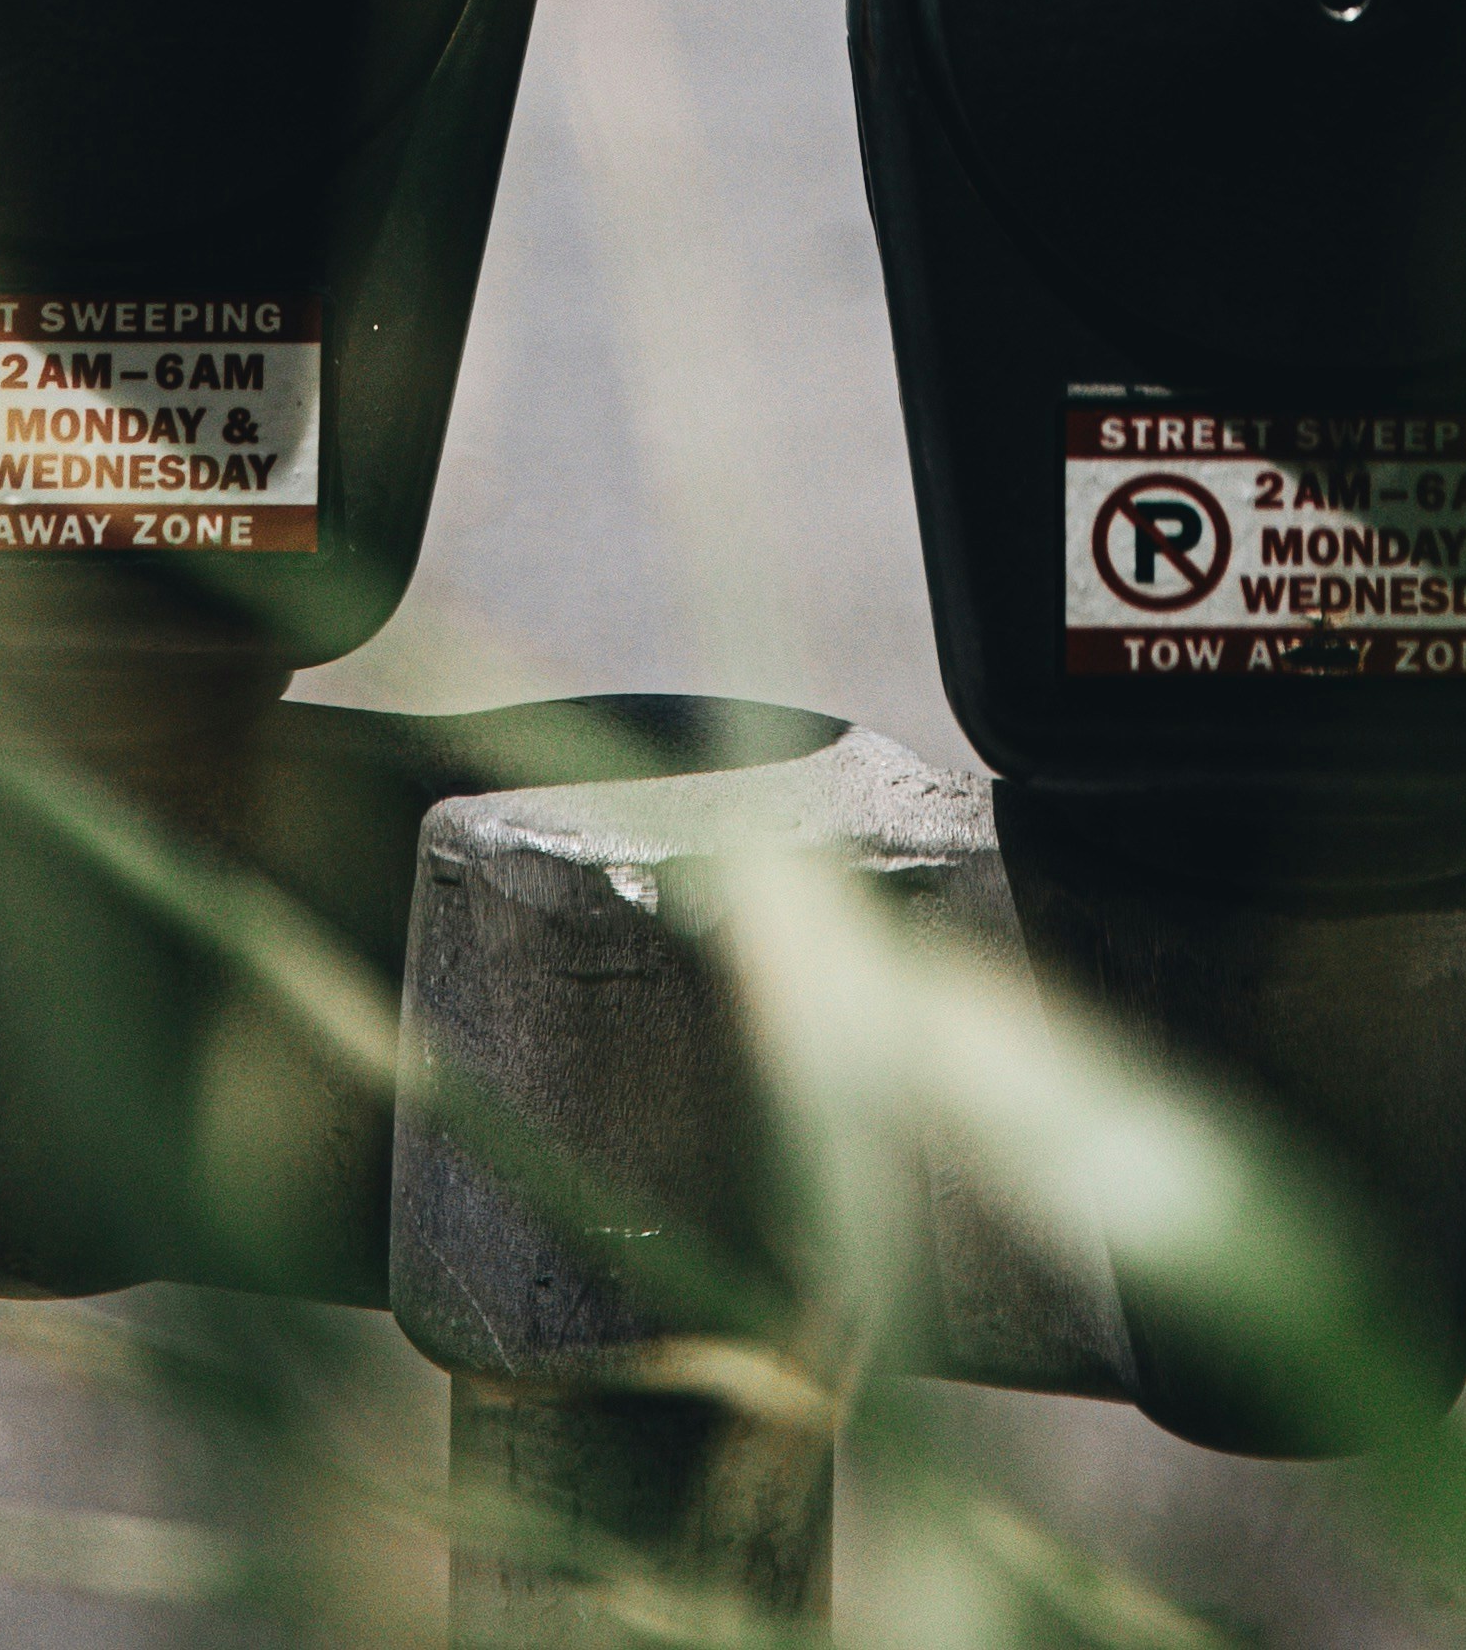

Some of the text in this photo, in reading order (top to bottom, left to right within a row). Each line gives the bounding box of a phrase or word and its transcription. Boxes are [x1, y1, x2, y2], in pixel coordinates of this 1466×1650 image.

[40, 302, 283, 334] SWEEPING
[5, 407, 260, 446] MONDAY &
[1100, 418, 1272, 451] STREET
[134, 513, 255, 547] ZONE
[1124, 637, 1225, 672] TOW
